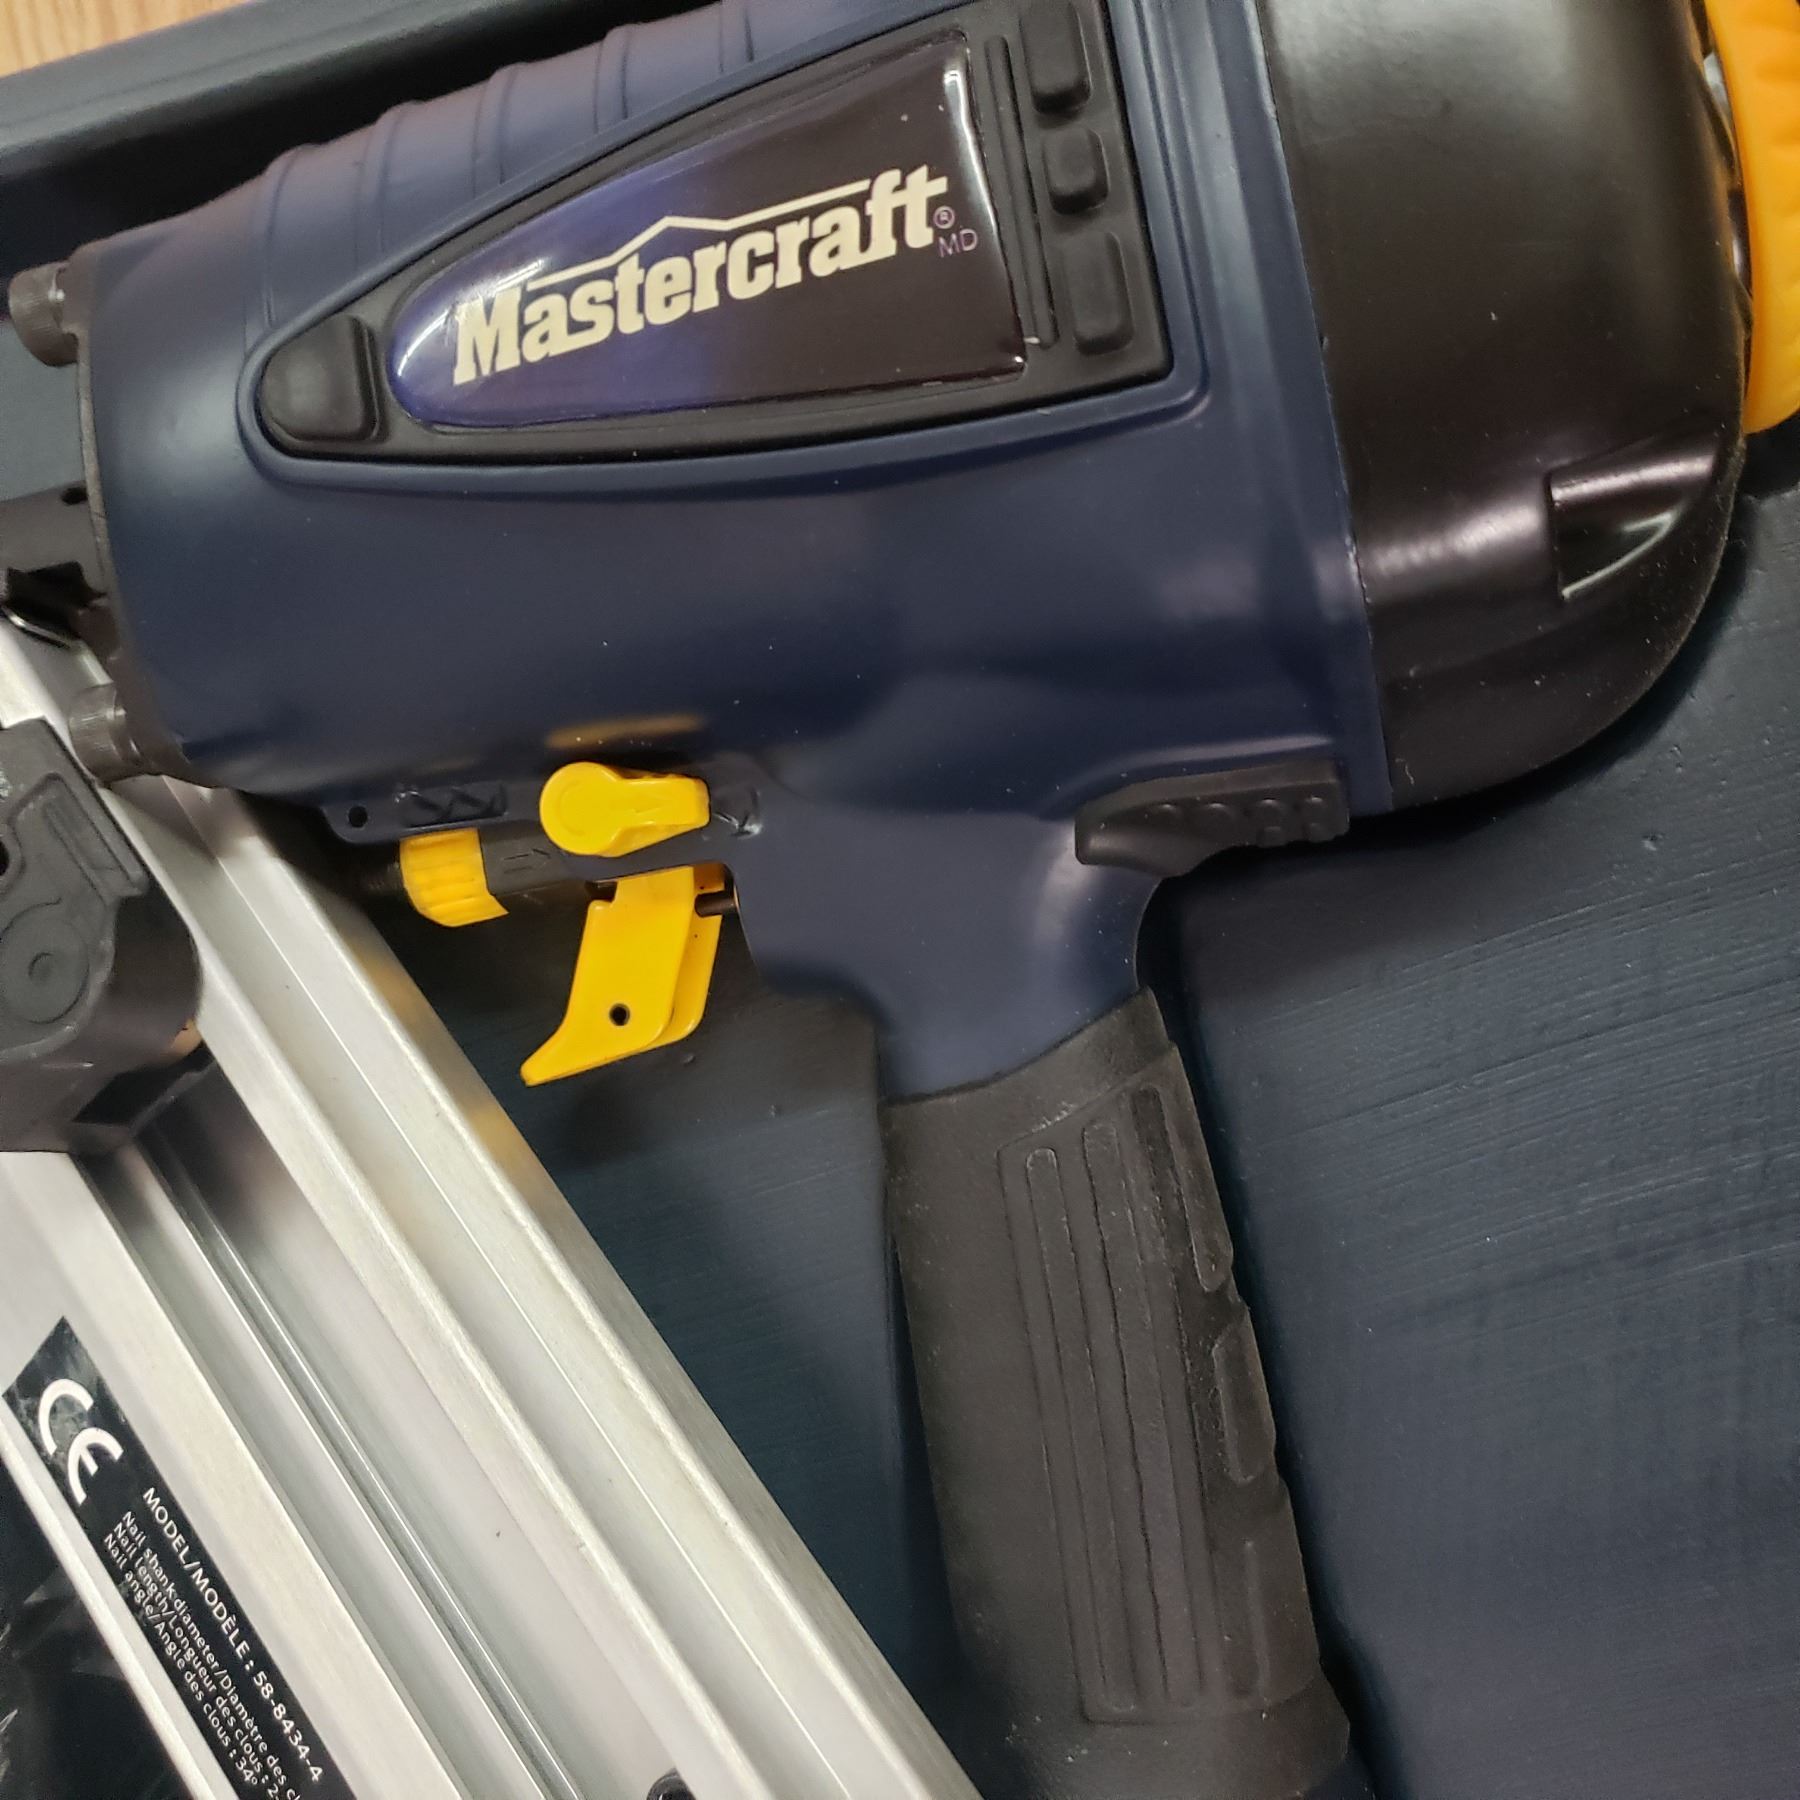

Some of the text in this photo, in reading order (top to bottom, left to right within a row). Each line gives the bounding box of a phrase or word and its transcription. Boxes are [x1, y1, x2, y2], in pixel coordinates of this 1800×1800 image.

[452, 163, 948, 386] Mastercraft
[938, 228, 978, 258] MD
[104, 1532, 128, 1570] Nail
[125, 1569, 185, 1670] angle/Angle
[184, 1670, 205, 1702] des
[203, 1702, 232, 1748] clous
[113, 1522, 138, 1559] Nail
[135, 1556, 217, 1693] length/Longueur
[215, 1696, 236, 1727] des
[234, 1727, 263, 1773] clous
[122, 1511, 147, 1548] Nail
[143, 1547, 175, 1601] shank
[174, 1598, 268, 1753] diameter/Diamètre
[266, 1754, 287, 1786] des
[142, 1487, 250, 1660] MODEL/MODÈLE
[253, 1670, 323, 1782] 58-8434-4
